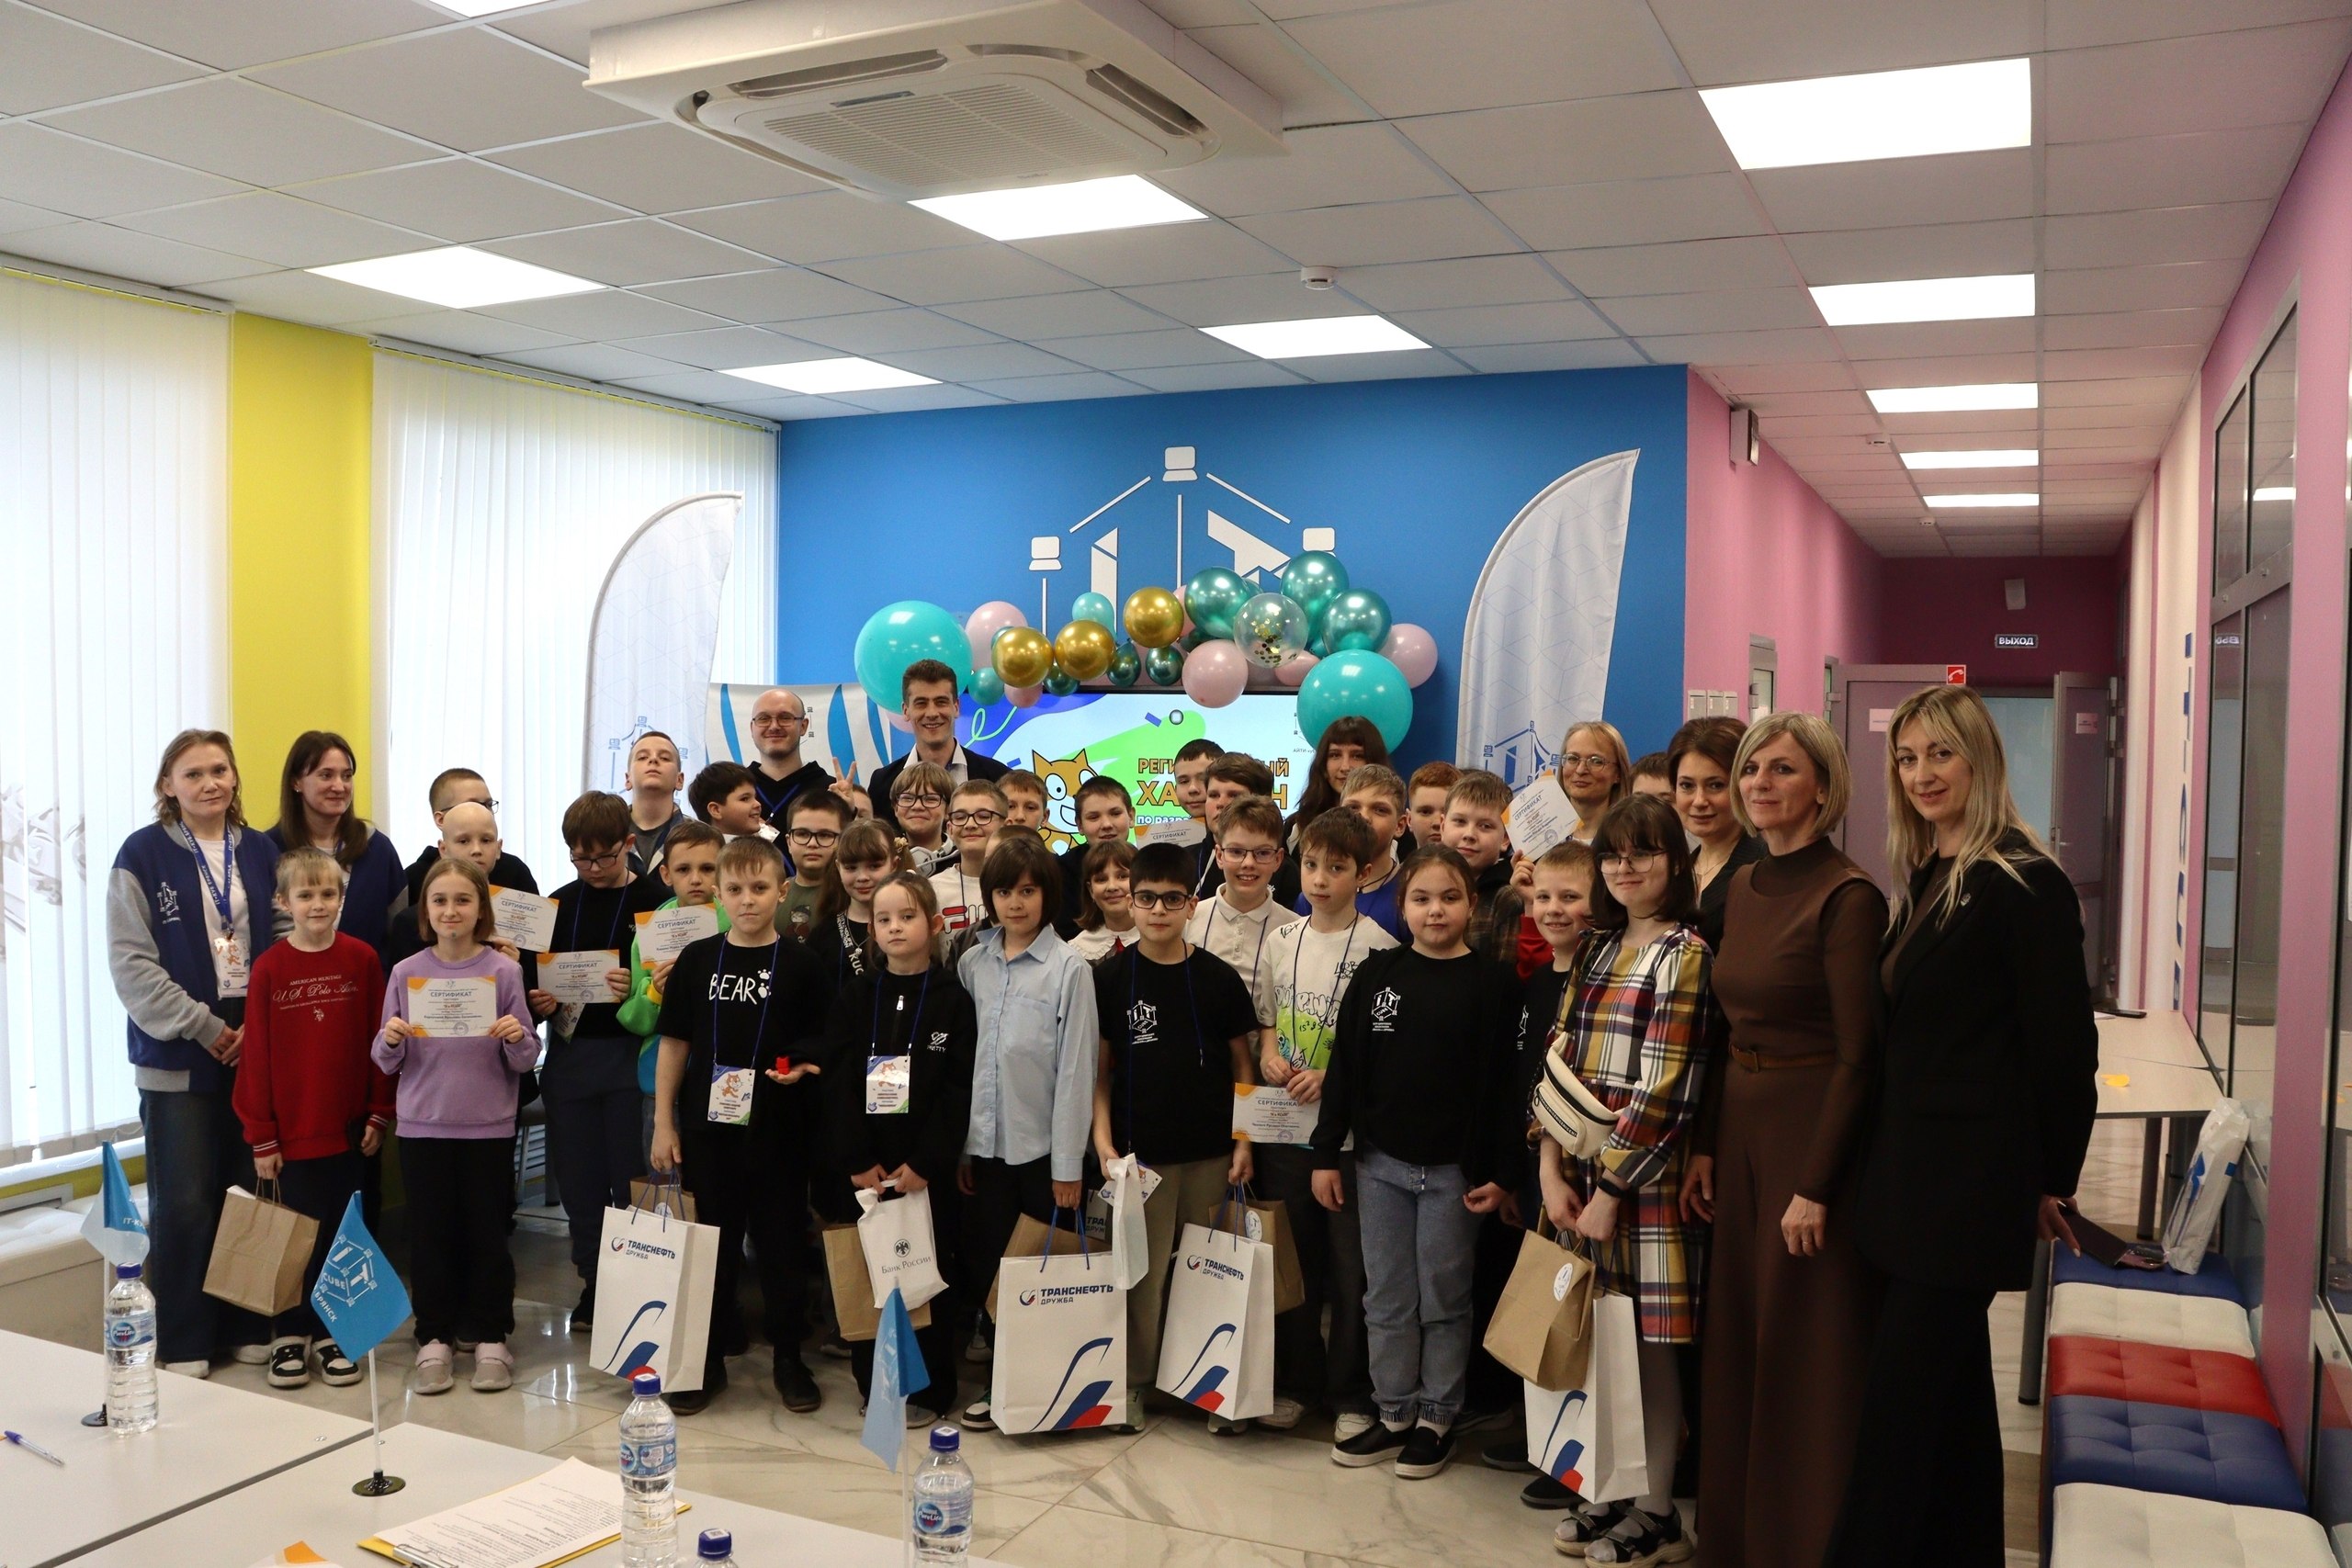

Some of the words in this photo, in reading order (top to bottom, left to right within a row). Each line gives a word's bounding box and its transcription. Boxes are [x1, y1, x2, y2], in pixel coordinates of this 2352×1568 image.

[1998, 637, 2034, 646] ВЫХОД
[1153, 831, 1187, 840] СЕРТИФИКАТ
[501, 900, 537, 912] СЕРТИФИКАТ
[657, 919, 696, 930] СЕРТИФИКАТ
[559, 962, 597, 970] СЕРТИФИКАТ
[289, 977, 317, 986] AMERICAN
[318, 974, 342, 982] HERITAGE
[307, 982, 332, 998] Polo
[708, 973, 757, 1005] BEAR
[1257, 1100, 1300, 1108] СЕРТИФИКА
[626, 1249, 649, 1259] ДРУЖБА
[628, 1240, 676, 1259] ТРАНСНЕФТЬ
[882, 1265, 901, 1274] Банк
[902, 1257, 932, 1269] России
[1204, 1258, 1244, 1280] ТРАНСНЕФТЬ
[1203, 1269, 1224, 1280] ДРУЖБА
[322, 1272, 346, 1290] CUBE
[1040, 1285, 1114, 1297] ТРАНСНЕФТЬ
[1040, 1296, 1074, 1305] ДРУЖБА
